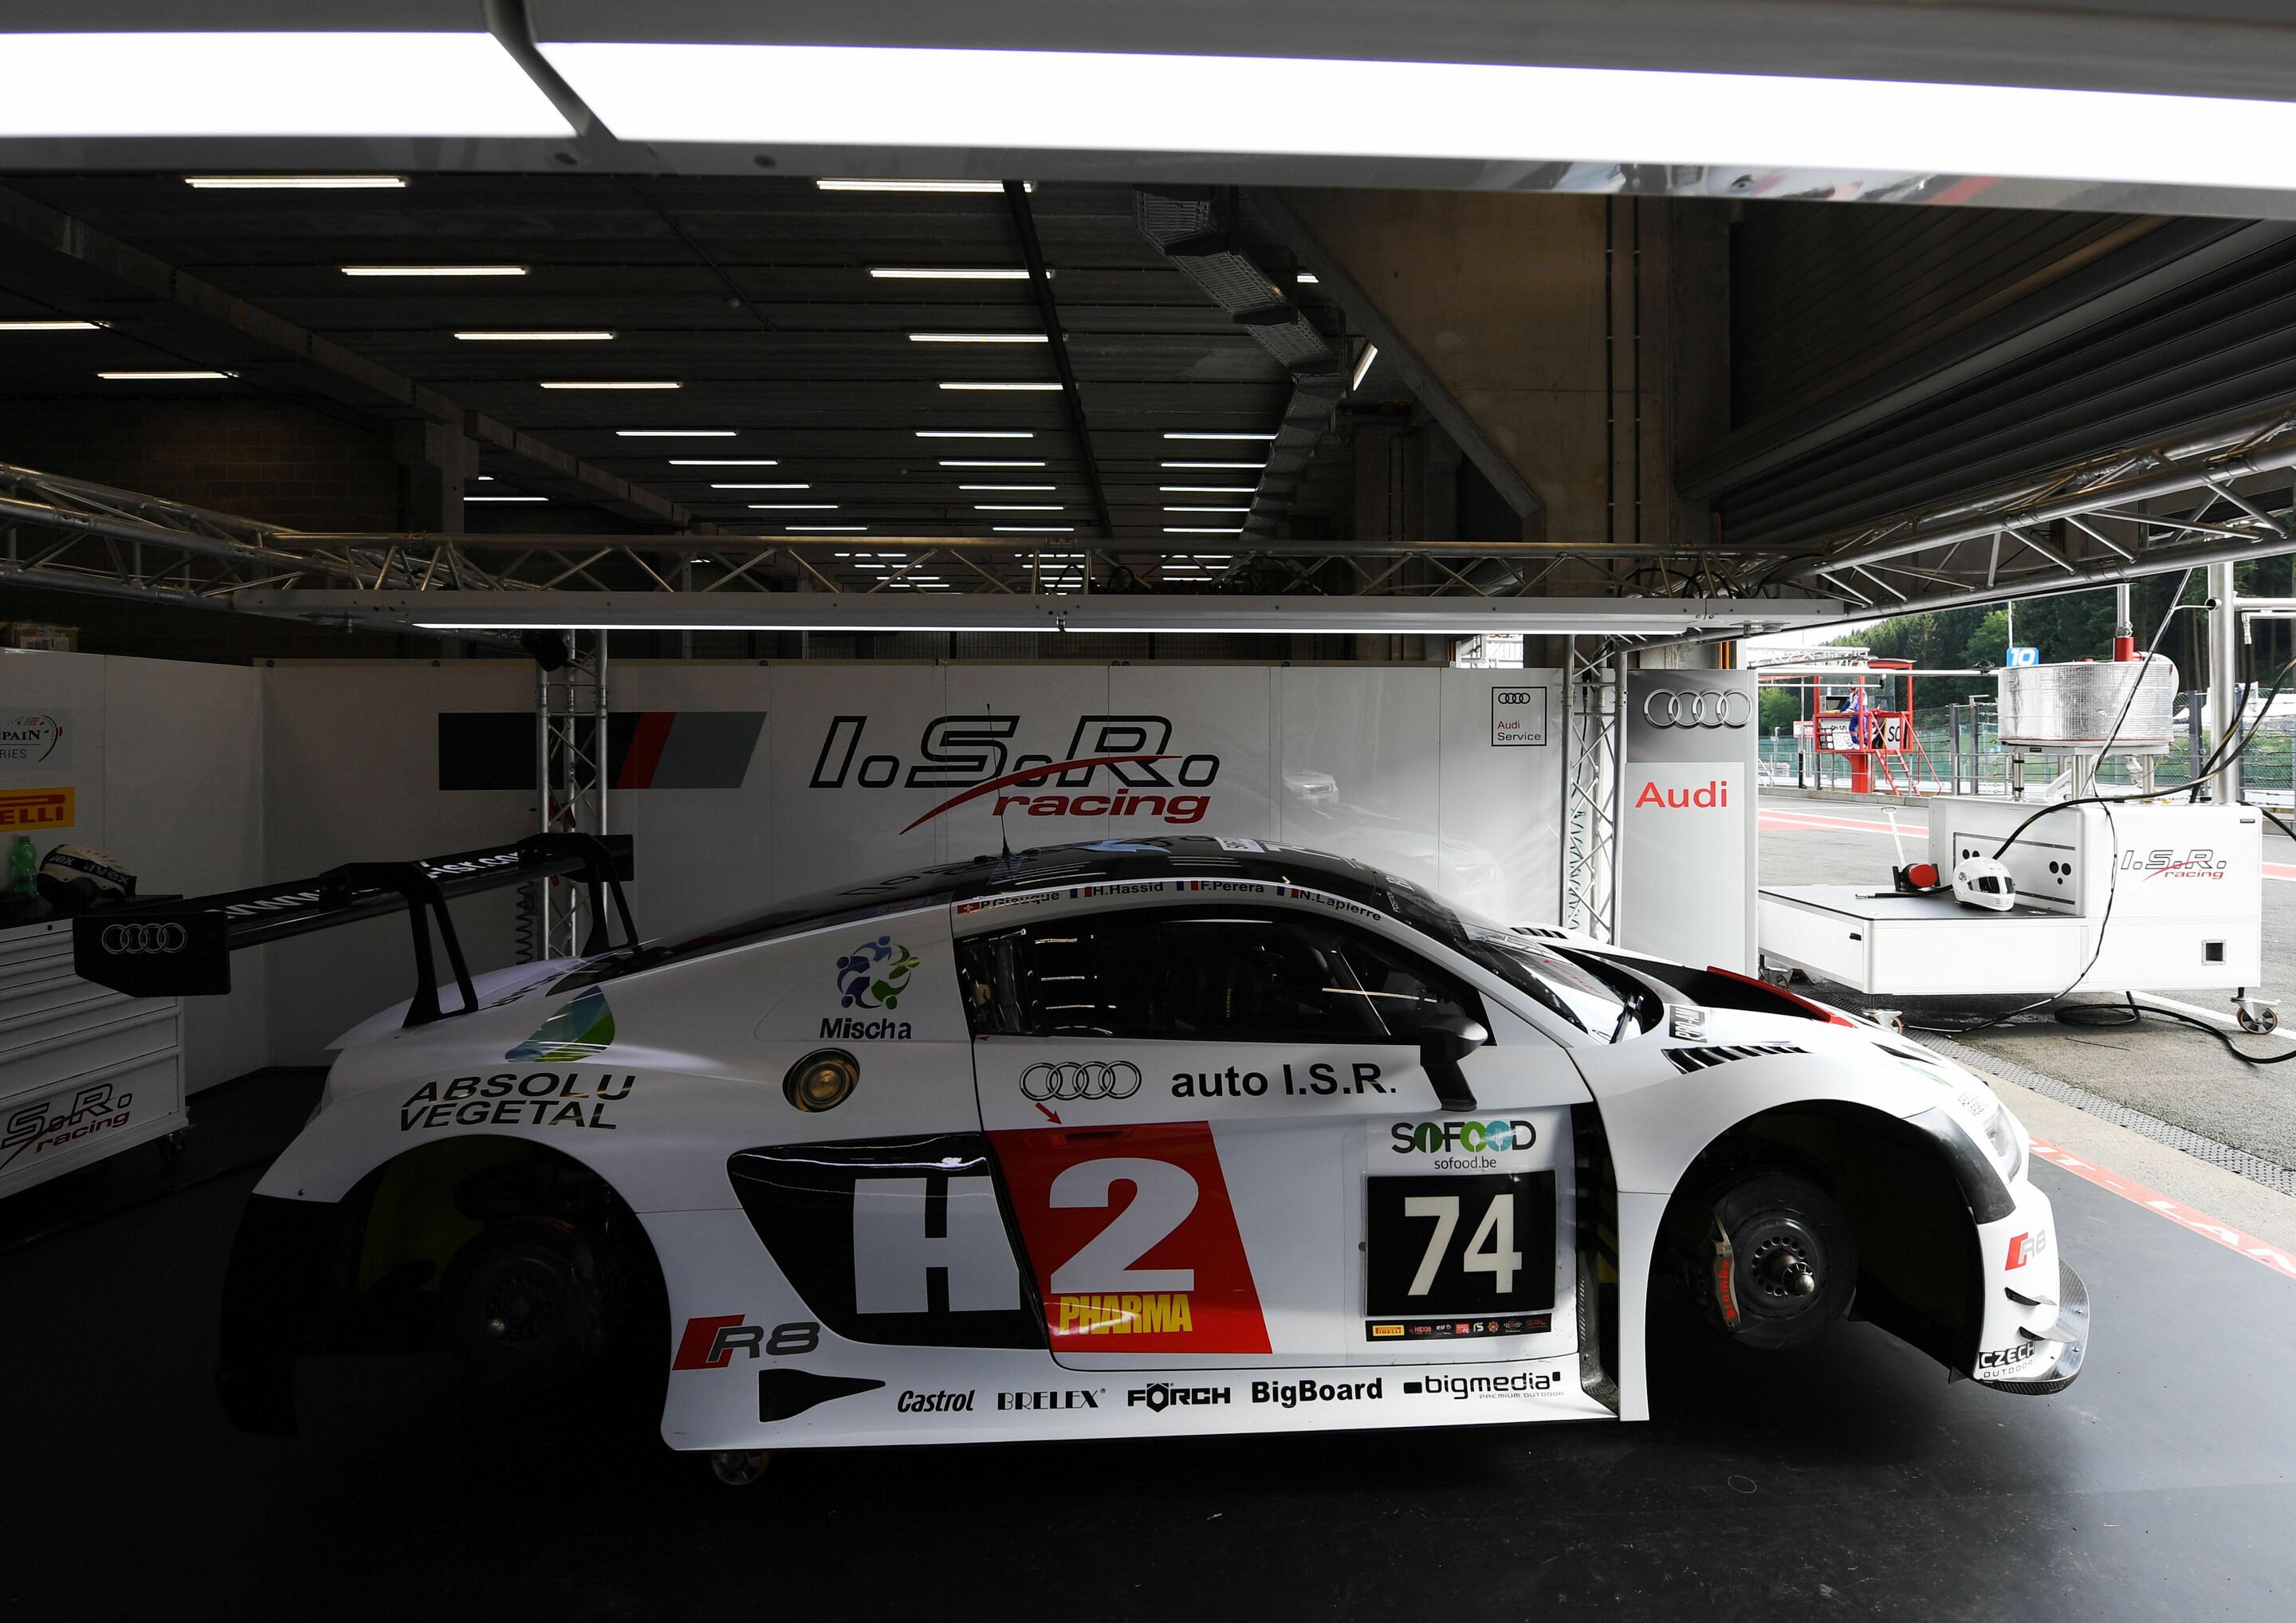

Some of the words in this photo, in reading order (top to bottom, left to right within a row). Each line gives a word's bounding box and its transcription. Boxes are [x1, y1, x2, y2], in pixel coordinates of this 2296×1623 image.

[2010, 649, 2036, 666] 10
[0, 729, 40, 741] PAIN
[1497, 721, 1520, 729] Audi
[1497, 731, 1541, 742] Service
[992, 788, 1211, 824] racing
[1635, 781, 1728, 808] Audi
[1201, 880, 1264, 894] F.Perera
[2164, 869, 2224, 880] racing
[1092, 882, 1164, 897] H.Hassid
[1299, 890, 1382, 922] N.Lapierre
[820, 1016, 912, 1039] Mischa
[402, 1073, 636, 1108] ABSOLU
[1170, 1067, 1268, 1098] auto
[1284, 1063, 1397, 1096] I.S.R.
[401, 1100, 617, 1131] VEGETAL
[36, 1111, 130, 1153] racing
[1391, 1120, 1537, 1154] SOFOOD
[1433, 1156, 1497, 1169] sofood.be
[1405, 1193, 1523, 1296] 74
[1058, 1294, 1193, 1337] PHARMA
[707, 1322, 820, 1362] R8
[1980, 1341, 2036, 1368] CZECH
[1983, 1359, 2033, 1378] OUTDOOR
[897, 1389, 975, 1413] Castrol
[1252, 1377, 1383, 1409] BigBoard
[1425, 1372, 1551, 1400] bigmedia
